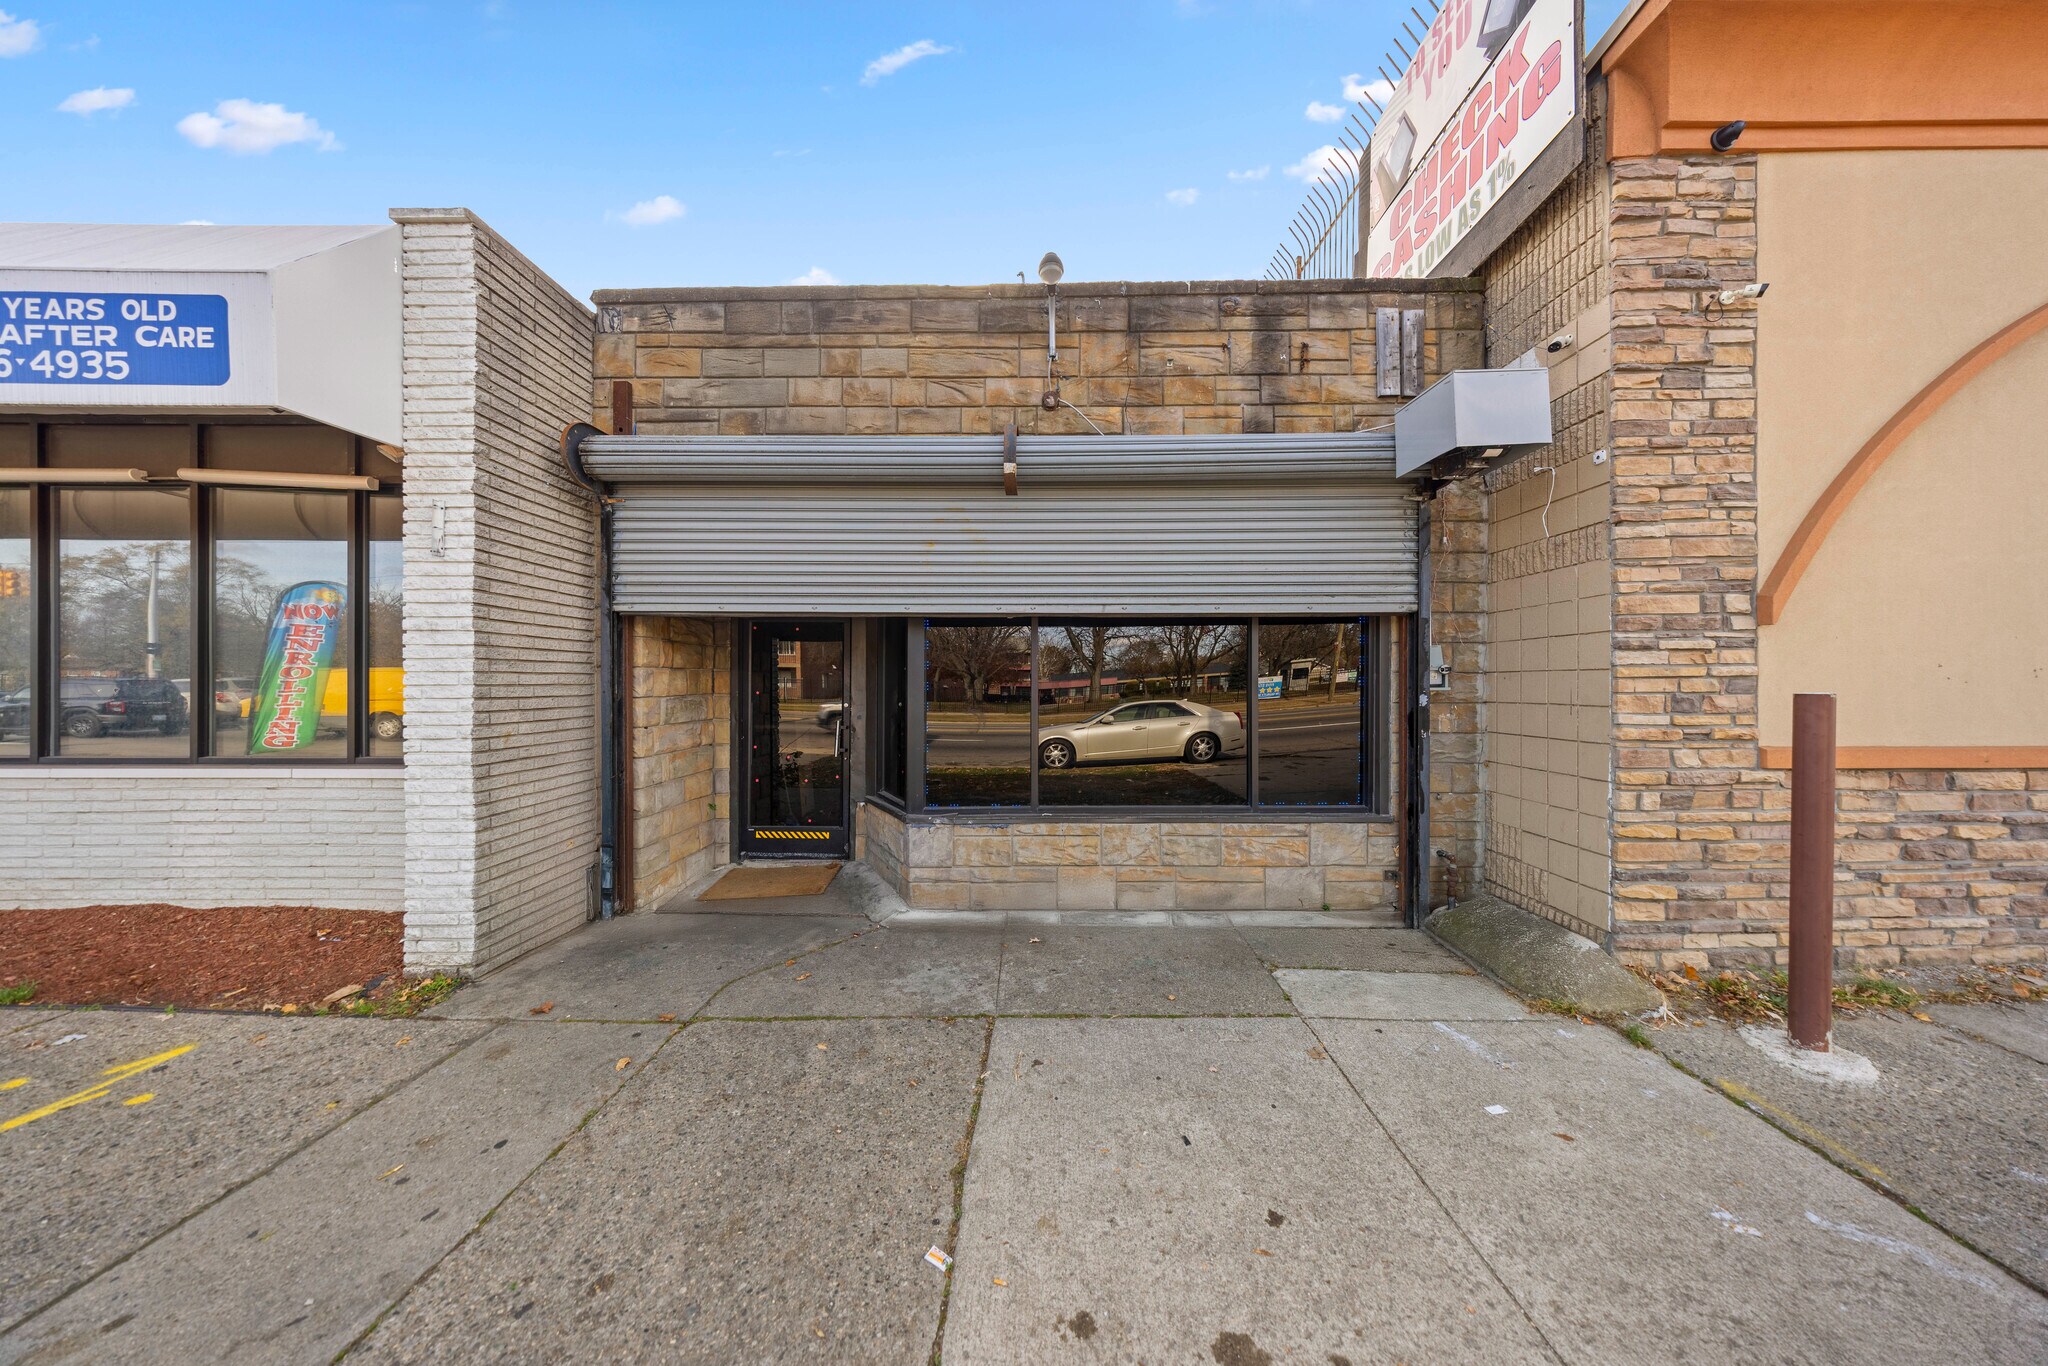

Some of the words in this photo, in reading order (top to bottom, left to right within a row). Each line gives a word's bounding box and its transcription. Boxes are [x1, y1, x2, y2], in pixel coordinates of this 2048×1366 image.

[1406, 45, 1425, 96] TO
[1422, 0, 1473, 101] YOU
[1372, 40, 1562, 278] CASHING
[1390, 20, 1531, 241] CHECK
[1418, 218, 1453, 277] LOW
[1457, 188, 1481, 238] AS
[1487, 149, 1515, 201] 1%
[0, 323, 118, 347] AFTER
[135, 326, 215, 348] CARE
[2, 297, 105, 321] YEARS
[121, 299, 177, 321] OLD
[283, 603, 340, 620] NOW
[262, 623, 325, 748] ENROLLING
